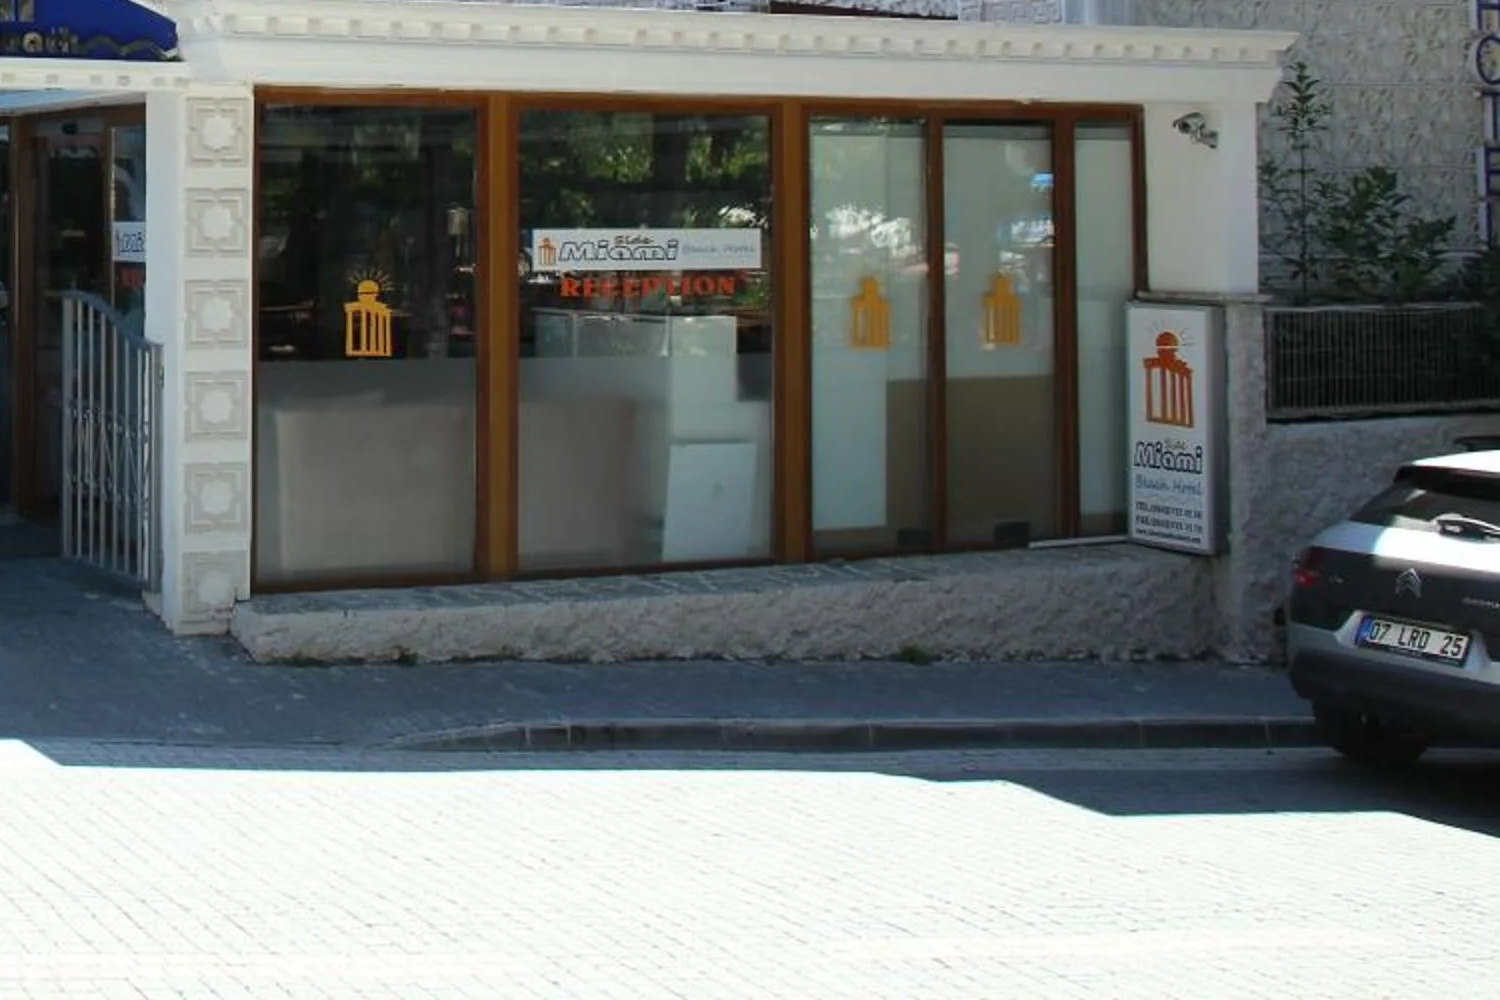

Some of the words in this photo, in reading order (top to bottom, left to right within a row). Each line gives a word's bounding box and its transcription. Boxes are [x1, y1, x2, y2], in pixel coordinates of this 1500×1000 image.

[558, 239, 679, 261] Miami
[559, 276, 738, 298] RECEPTION
[1133, 441, 1203, 474] Miami
[1370, 622, 1392, 642] 07
[1397, 626, 1431, 650] LRD
[1439, 634, 1464, 658] 25
